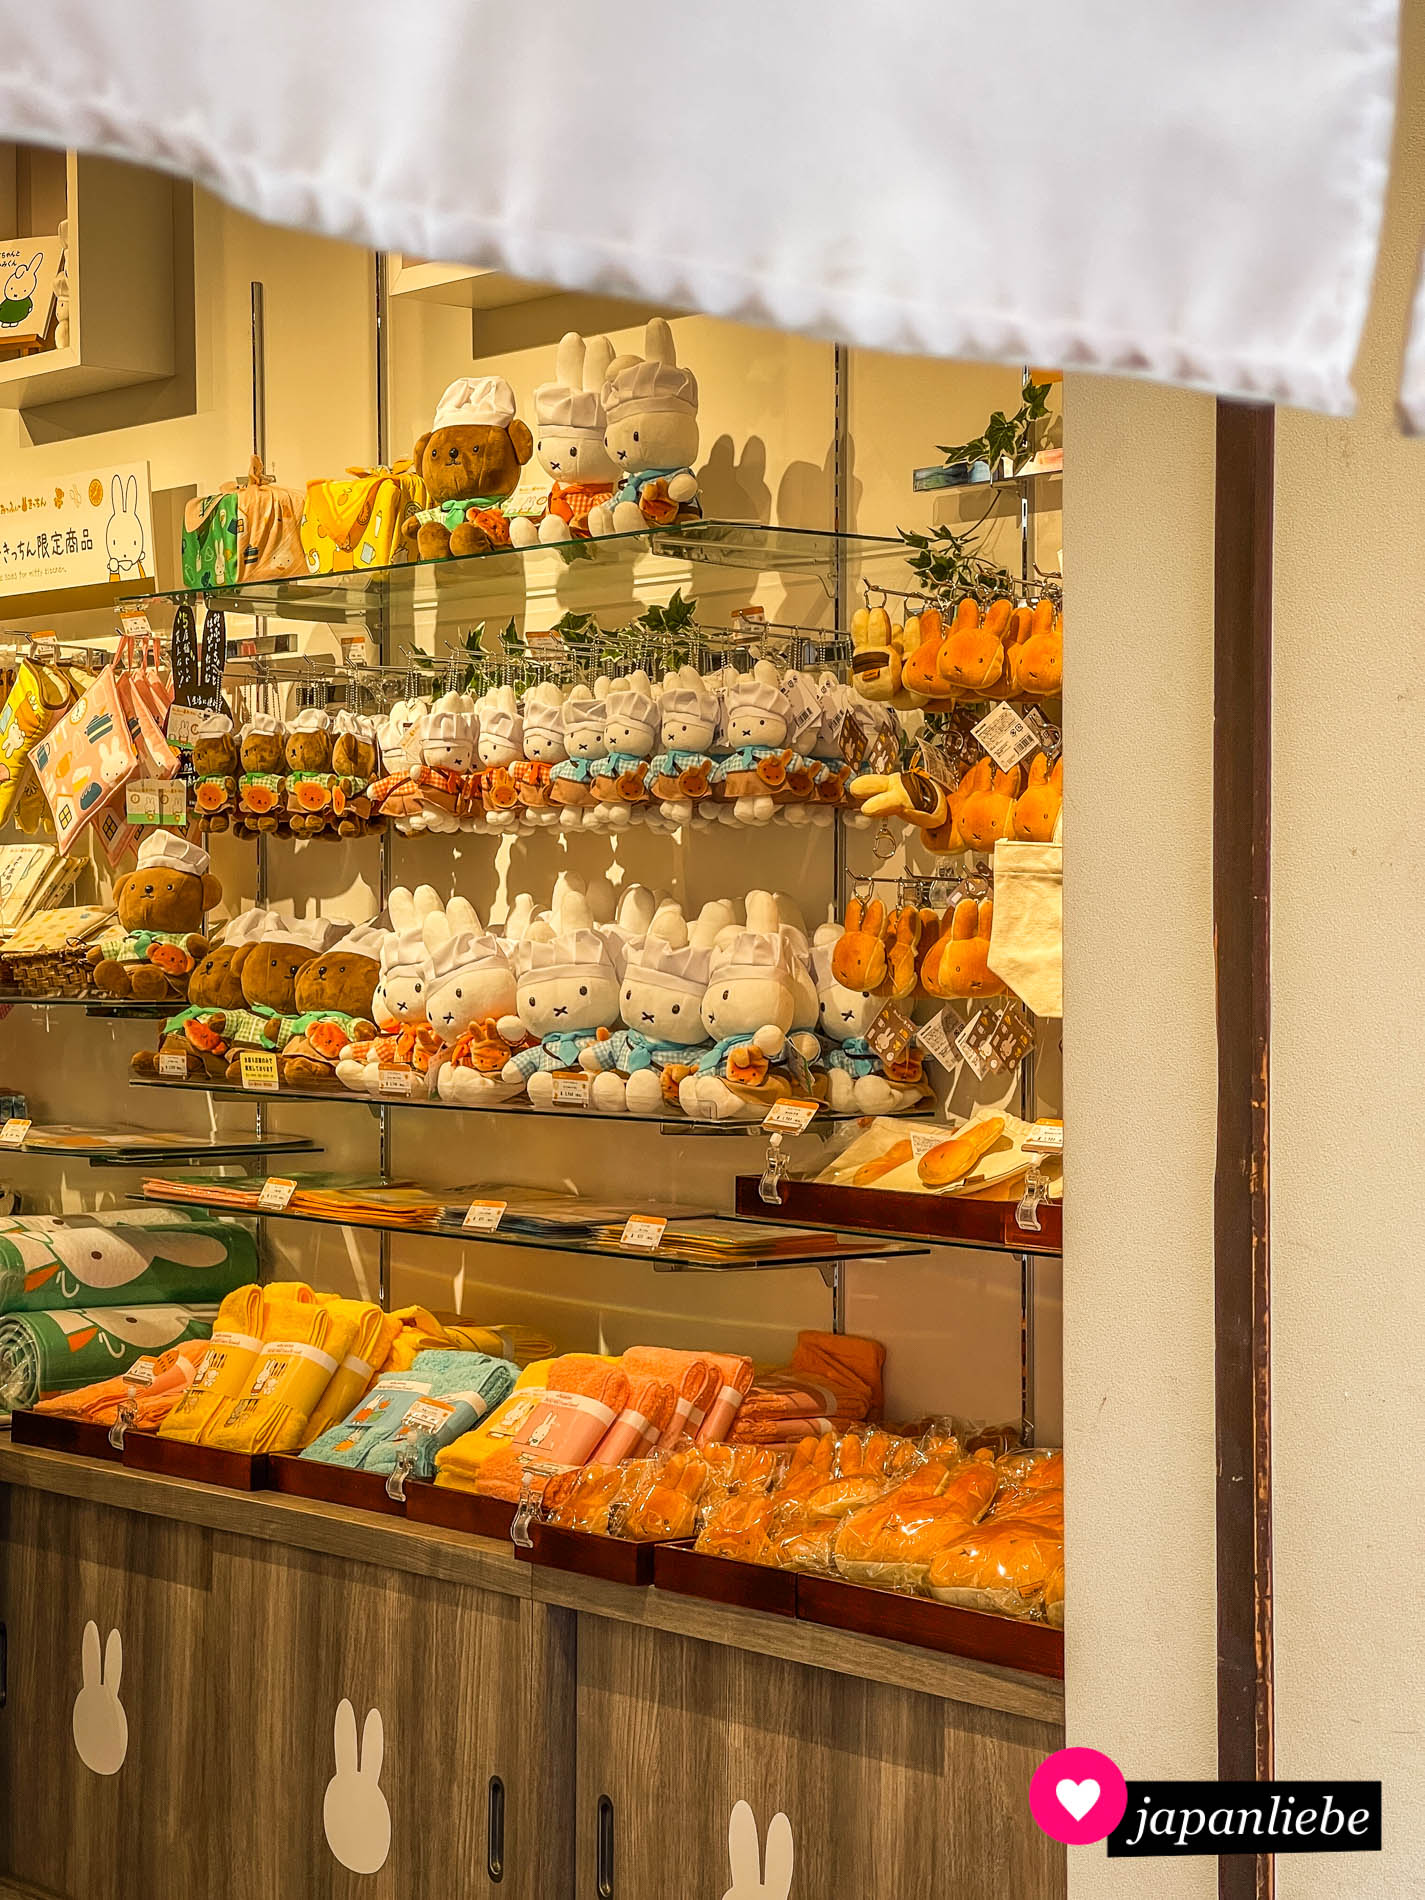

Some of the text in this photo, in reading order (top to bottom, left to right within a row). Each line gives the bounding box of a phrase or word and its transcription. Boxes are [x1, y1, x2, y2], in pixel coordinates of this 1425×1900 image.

[0, 250, 20, 259] ちゃんと
[0, 527, 93, 564] きっちん限定商品
